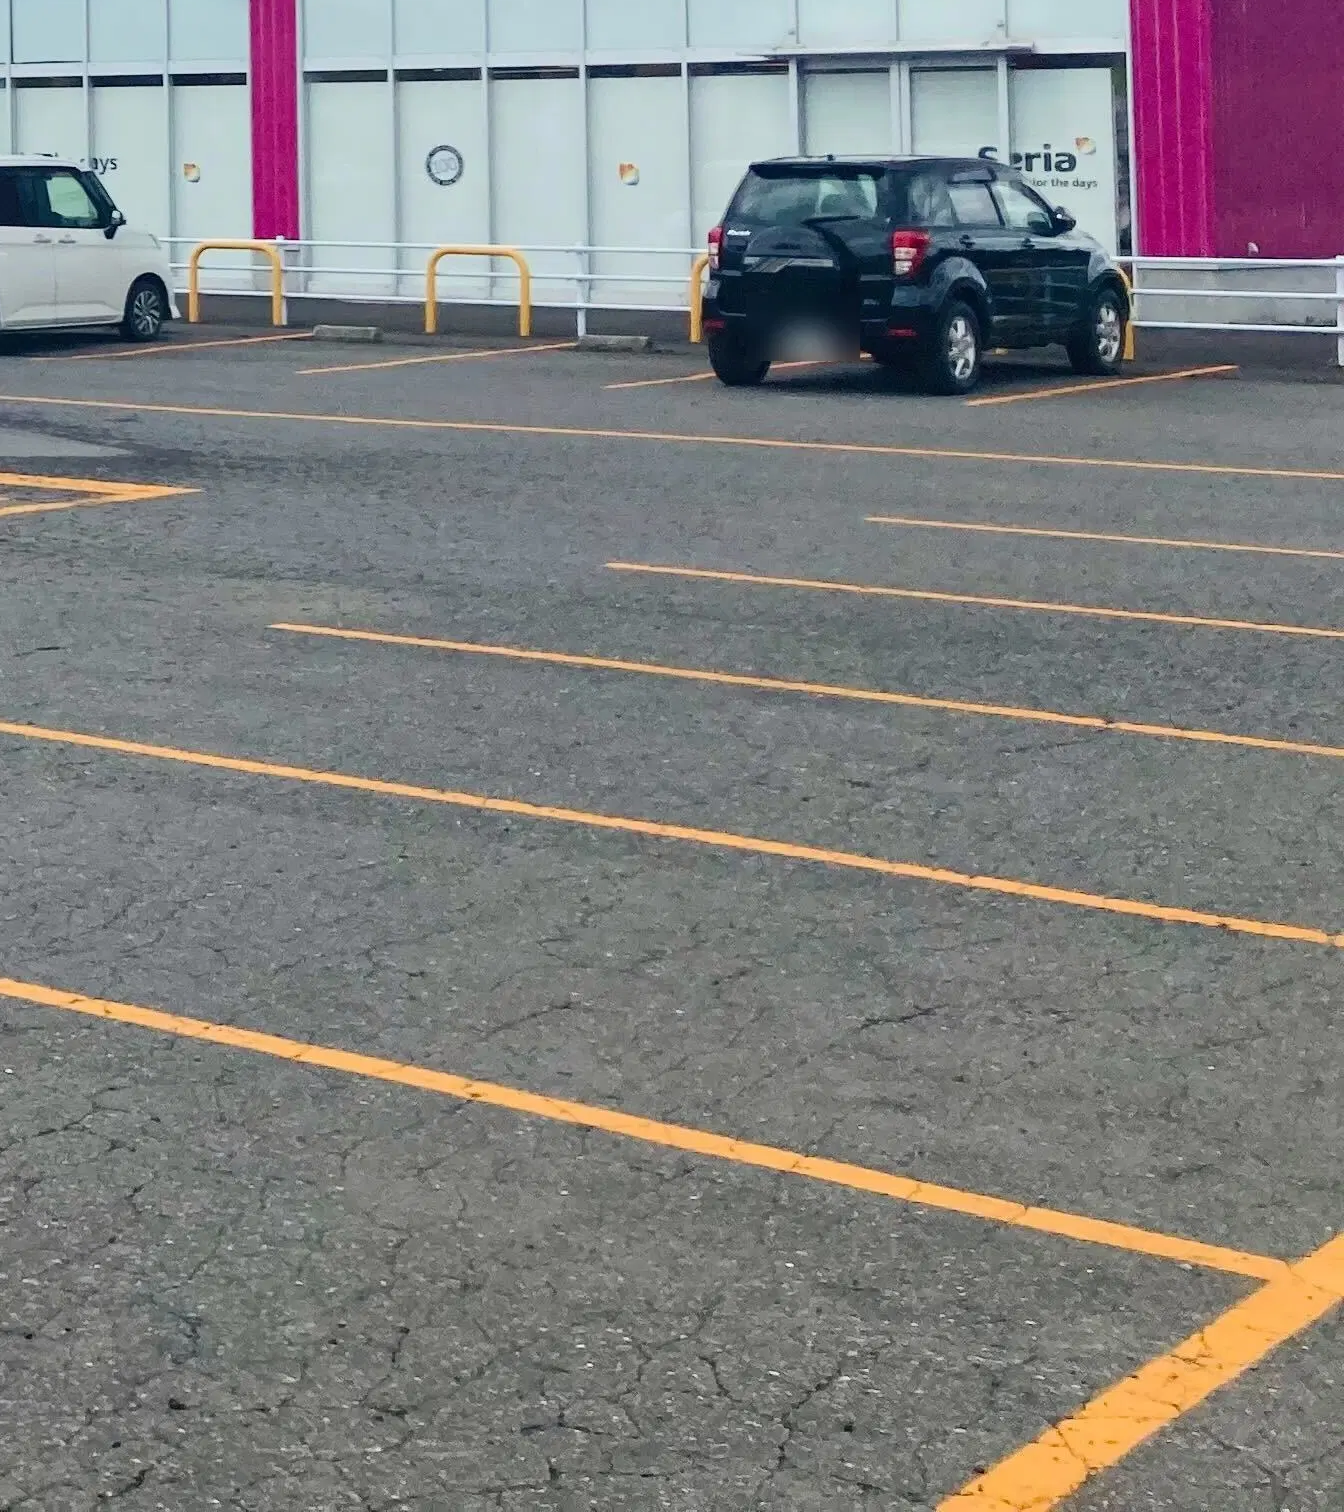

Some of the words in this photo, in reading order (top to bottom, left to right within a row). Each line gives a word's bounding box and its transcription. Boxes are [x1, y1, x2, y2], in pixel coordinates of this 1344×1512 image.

[88, 156, 118, 176] ays
[1051, 177, 1069, 188] the
[1072, 177, 1098, 190] days
